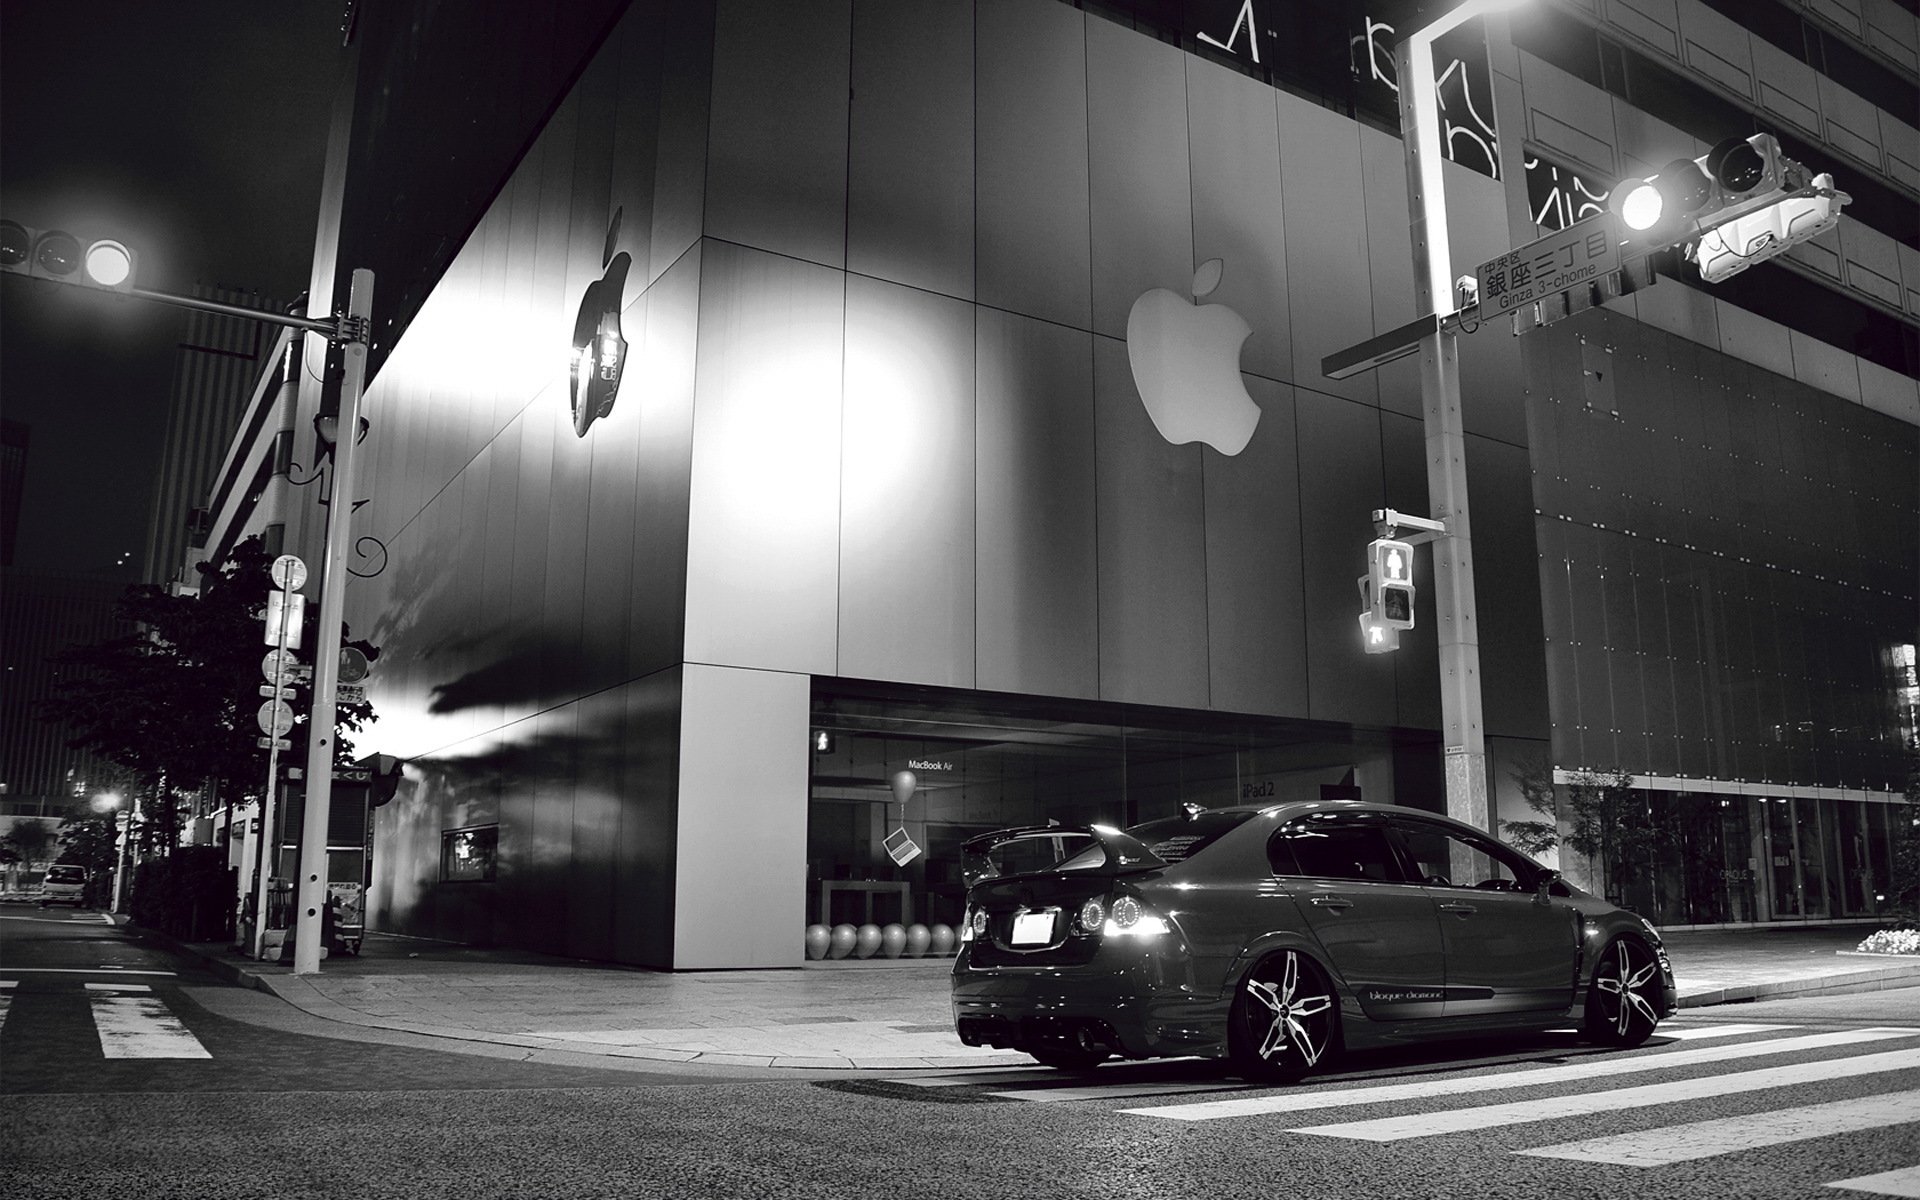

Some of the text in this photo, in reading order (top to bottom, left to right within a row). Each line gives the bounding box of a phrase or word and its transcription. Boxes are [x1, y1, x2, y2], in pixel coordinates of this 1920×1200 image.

[1485, 251, 1521, 274] 中央区
[1486, 230, 1607, 300] 銀座三丁目
[1499, 263, 1597, 309] Ginza 3-chome
[908, 759, 953, 771] MacBook Air
[1243, 781, 1275, 798] iPad 2
